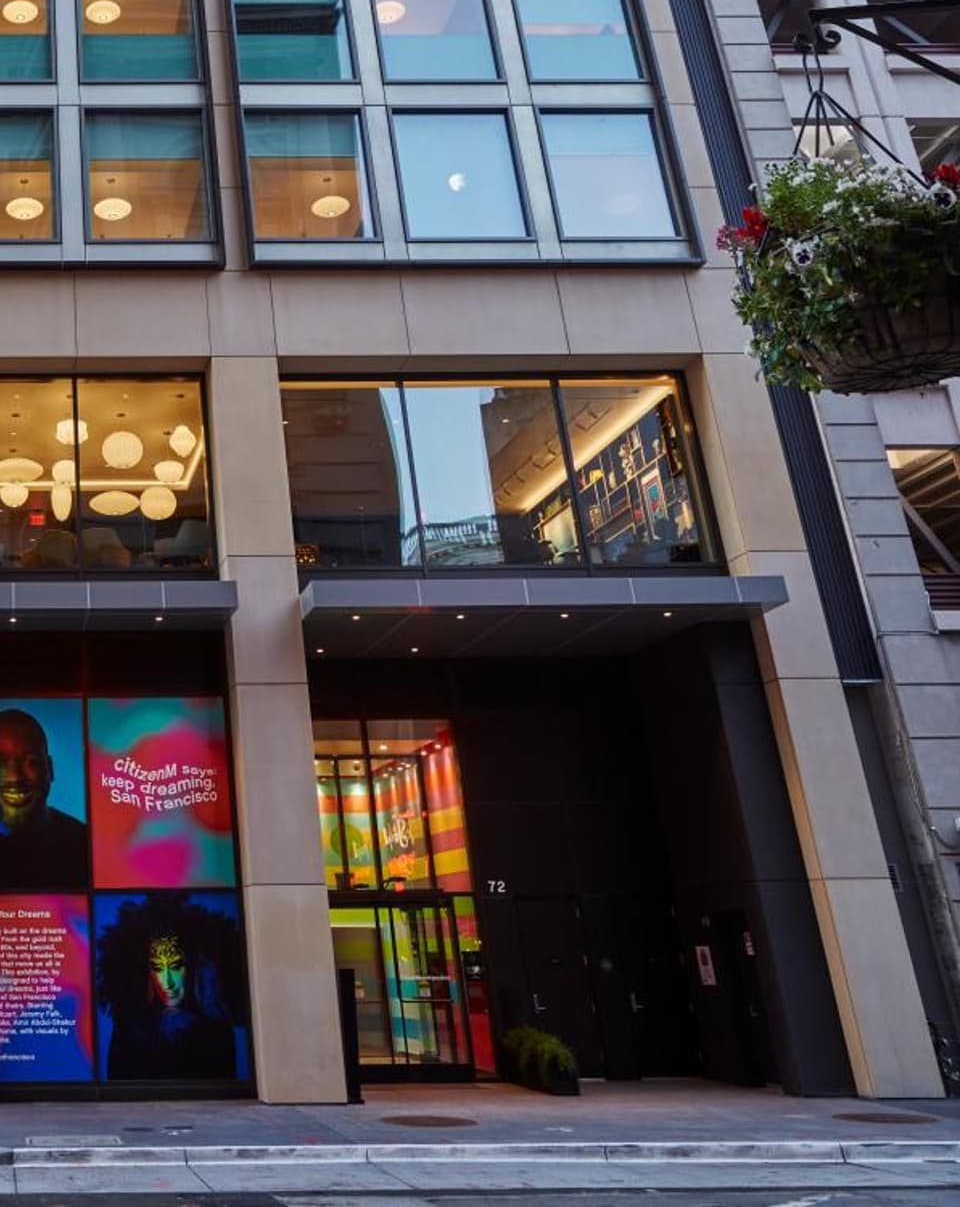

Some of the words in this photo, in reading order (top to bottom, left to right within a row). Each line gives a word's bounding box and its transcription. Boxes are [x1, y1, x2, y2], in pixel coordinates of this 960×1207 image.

[113, 756, 178, 782] citizenM
[101, 773, 136, 792] keep
[110, 789, 141, 809] San
[144, 791, 218, 812] Francisco
[487, 880, 507, 893] 72
[17, 909, 52, 918] Dreams
